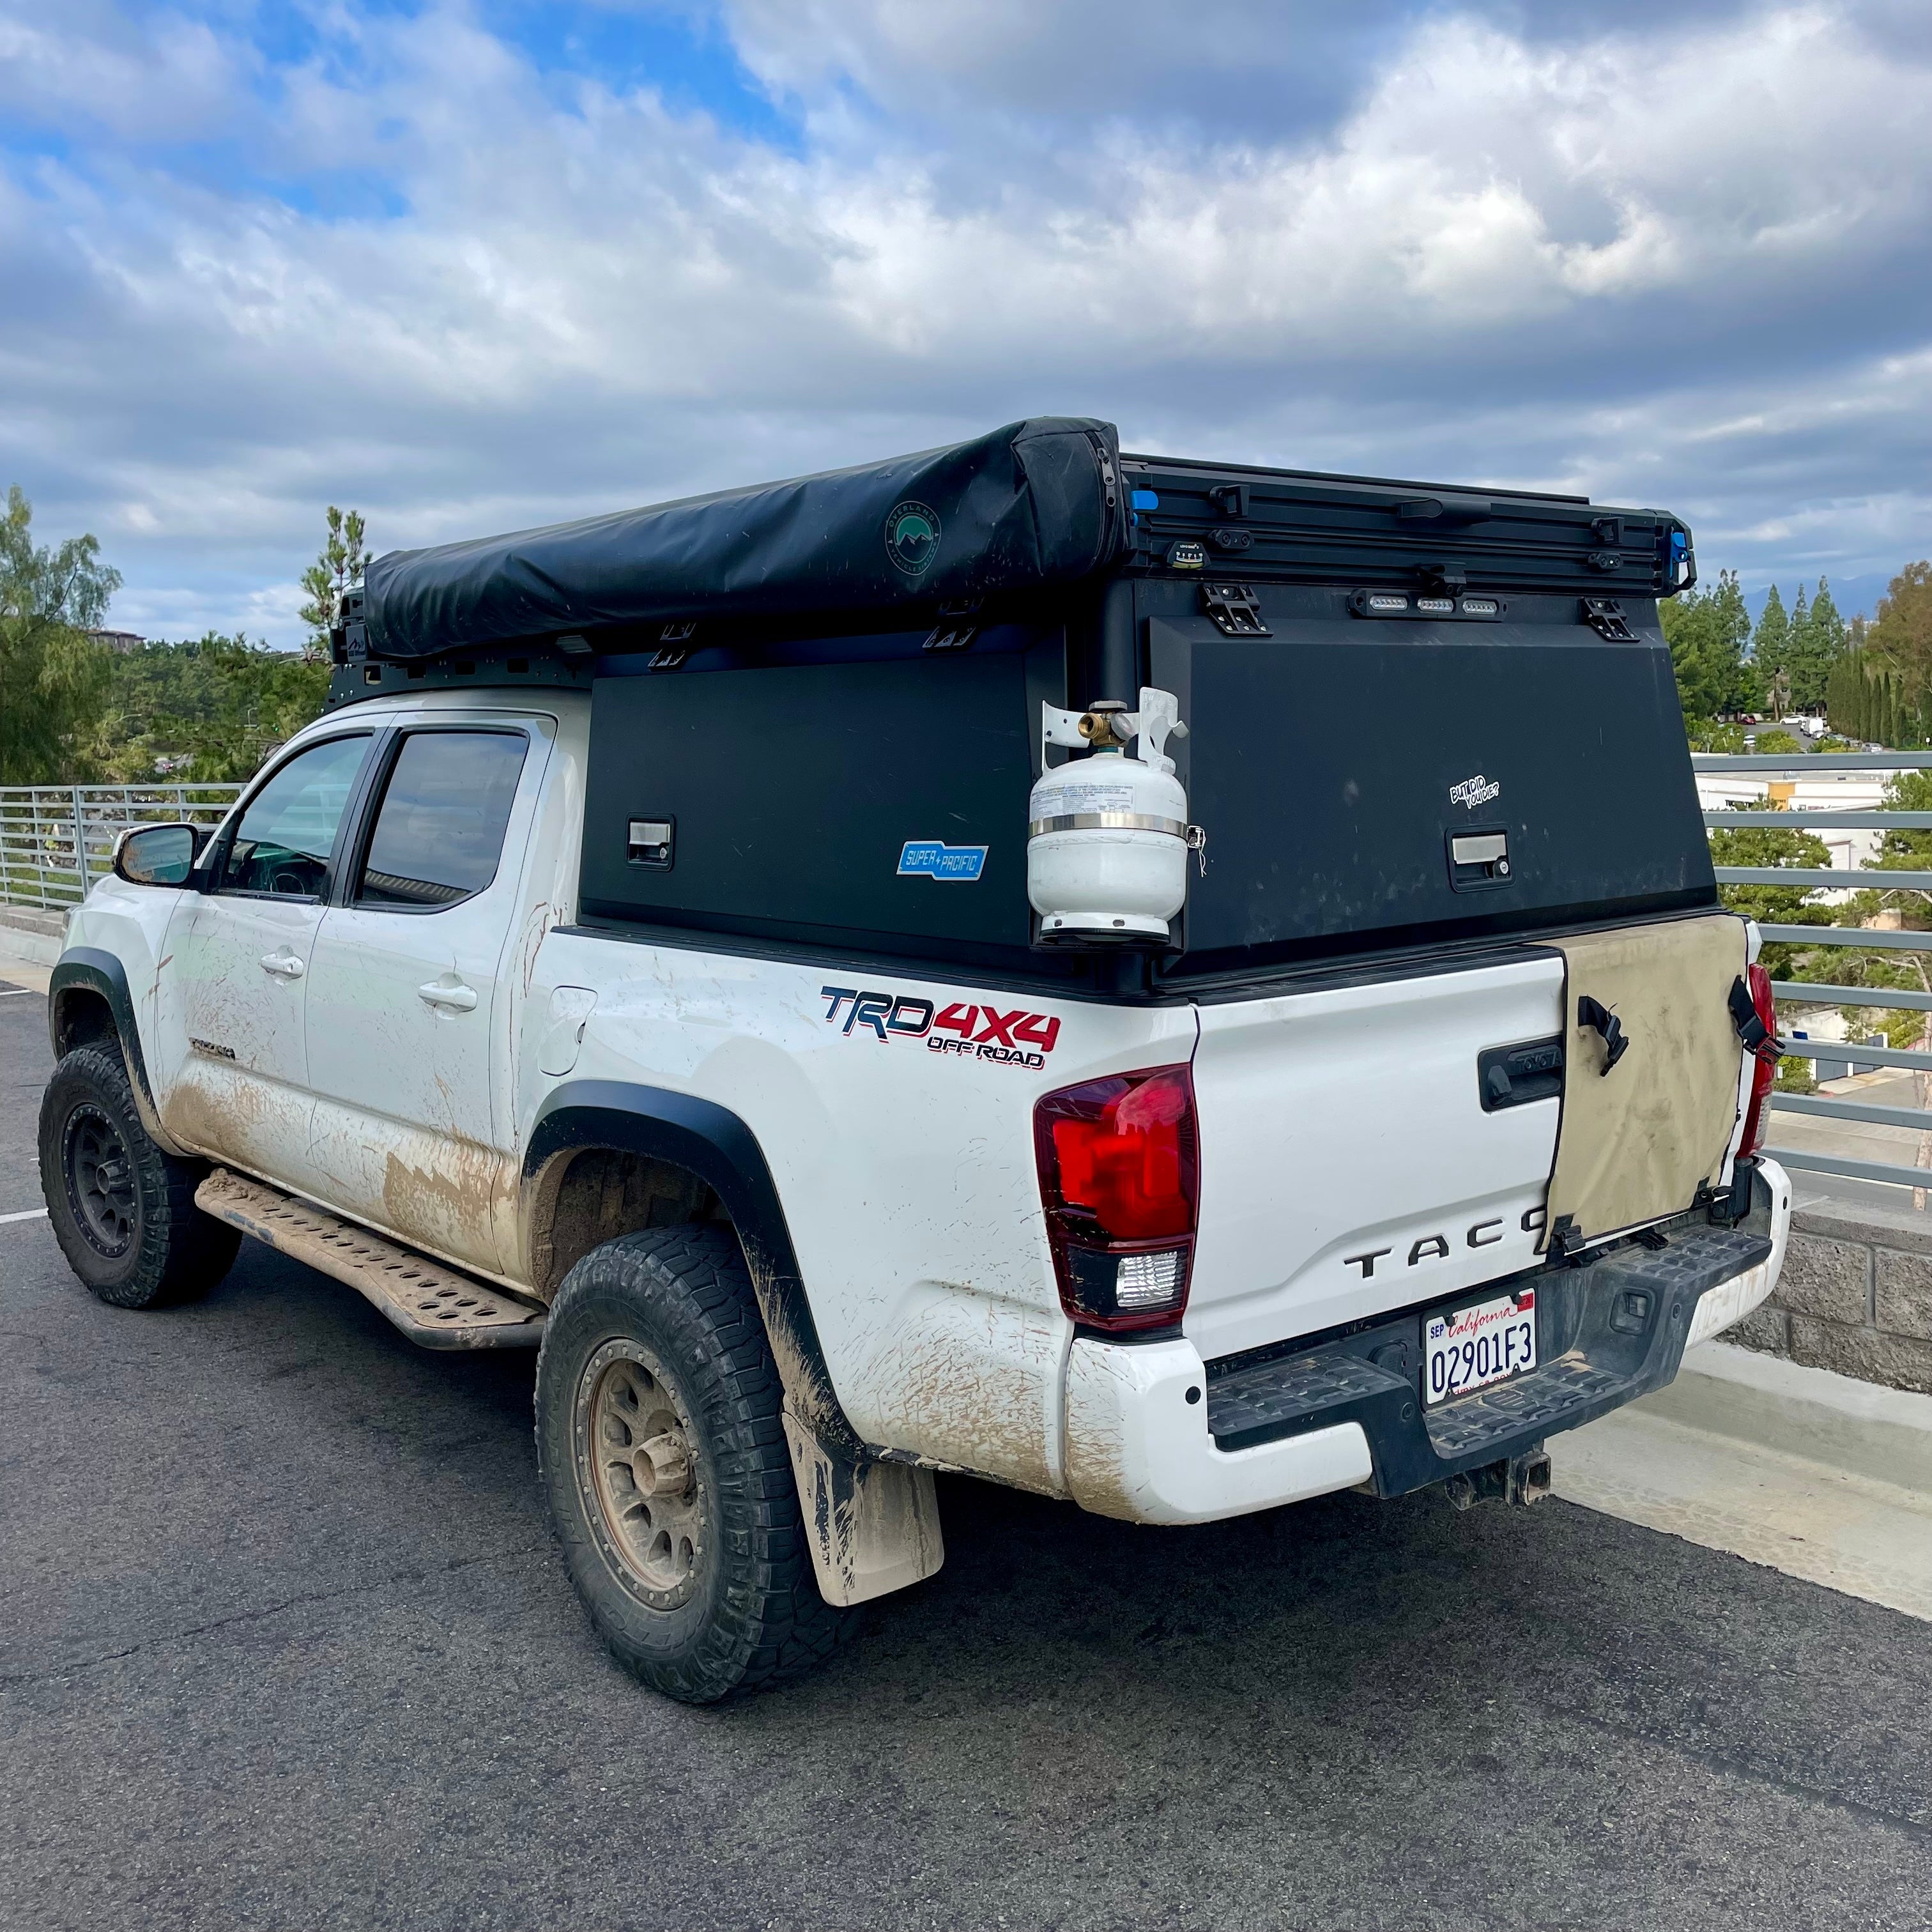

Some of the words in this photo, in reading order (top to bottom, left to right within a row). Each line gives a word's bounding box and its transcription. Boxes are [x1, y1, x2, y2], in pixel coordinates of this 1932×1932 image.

[889, 504, 935, 527] OVERLAND
[1450, 781, 1468, 804] BUT
[1469, 775, 1485, 794] DID
[1466, 790, 1482, 809] YOU
[1482, 781, 1499, 801] DIE?
[906, 850, 937, 866] SUPER
[940, 855, 978, 871] PACIFIC
[820, 986, 936, 1044] TRD
[927, 1036, 975, 1056] OFF
[976, 1044, 1045, 1070] ROAD
[1430, 1324, 1445, 1339] SEP
[1448, 1307, 1518, 1338] California
[1432, 1322, 1531, 1393] 02901F3
